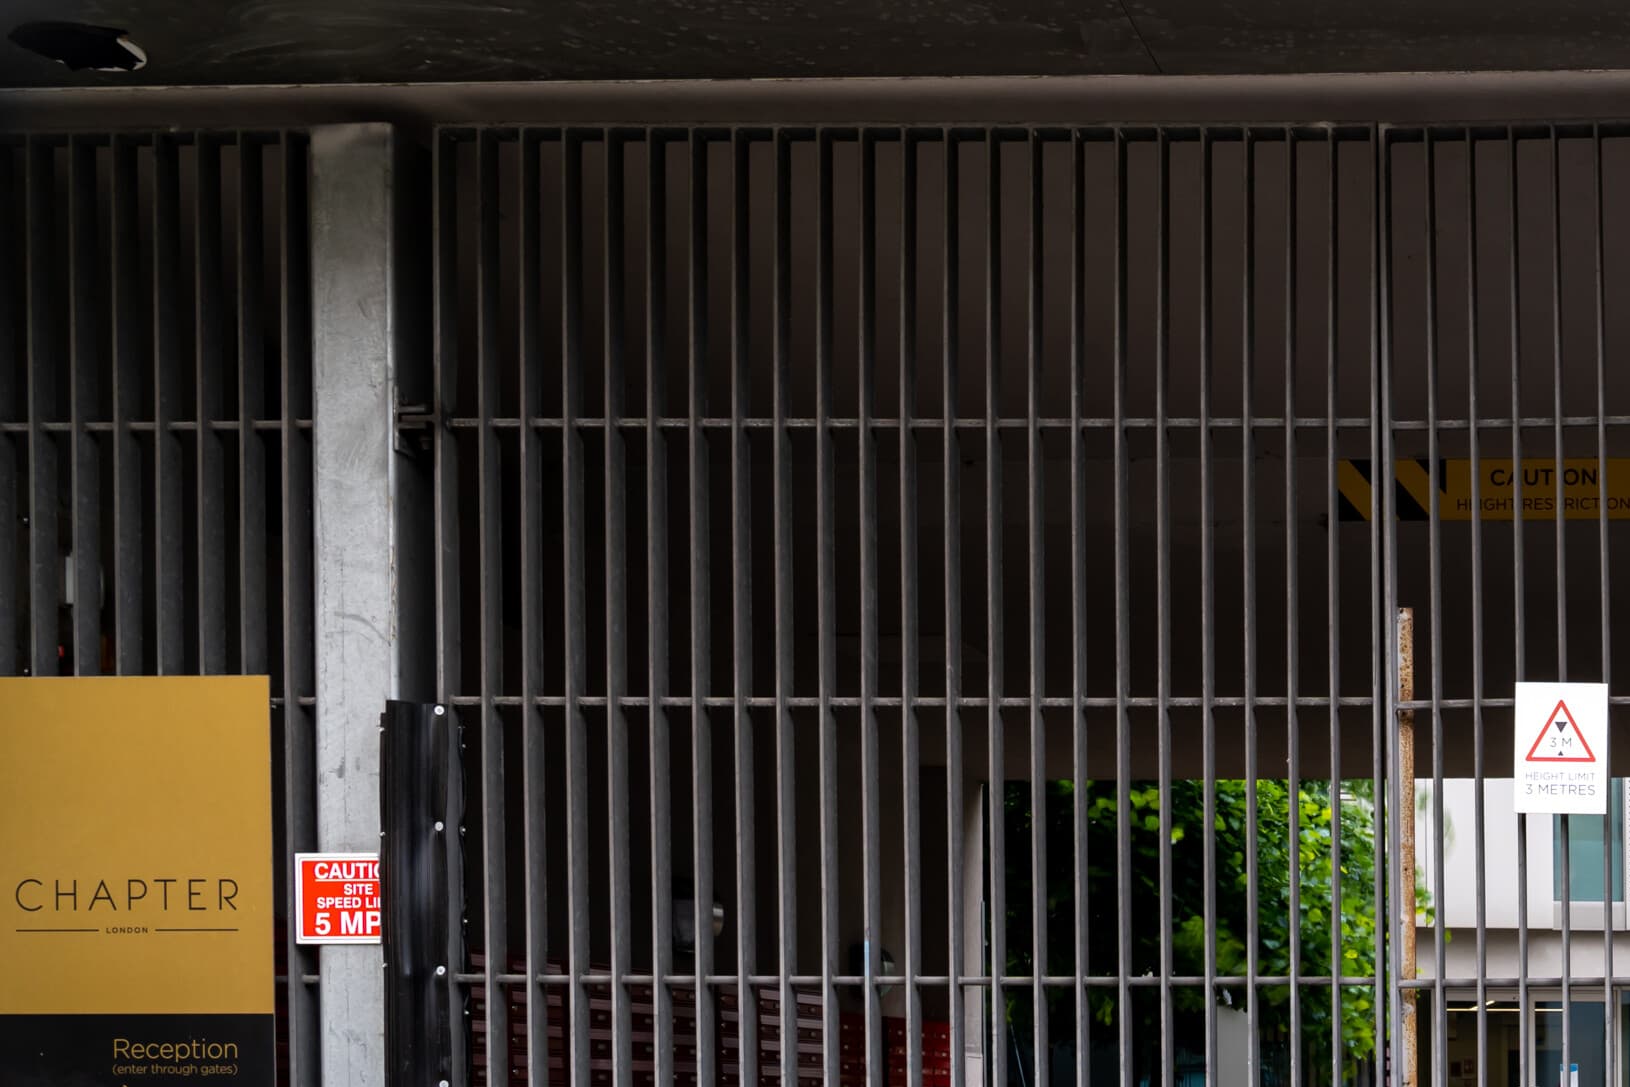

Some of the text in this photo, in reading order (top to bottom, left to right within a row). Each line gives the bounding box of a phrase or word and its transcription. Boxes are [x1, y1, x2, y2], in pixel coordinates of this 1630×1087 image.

[1490, 469, 1598, 487] CUTON
[1456, 497, 1630, 512] HIGHT RESRICTON
[1549, 736, 1572, 748] 3 M
[1525, 771, 1595, 781] HEIGHT LIMIT
[1525, 783, 1596, 796] 3 METRES
[314, 862, 380, 879] CAUTI
[15, 878, 239, 912] CHAPTER
[343, 883, 374, 895] SITE
[316, 896, 362, 909] SPEED
[314, 910, 381, 935] 5 MP
[106, 926, 149, 934] LONDON
[113, 1038, 239, 1062] Reception
[112, 1064, 239, 1076] (enter through gates)
